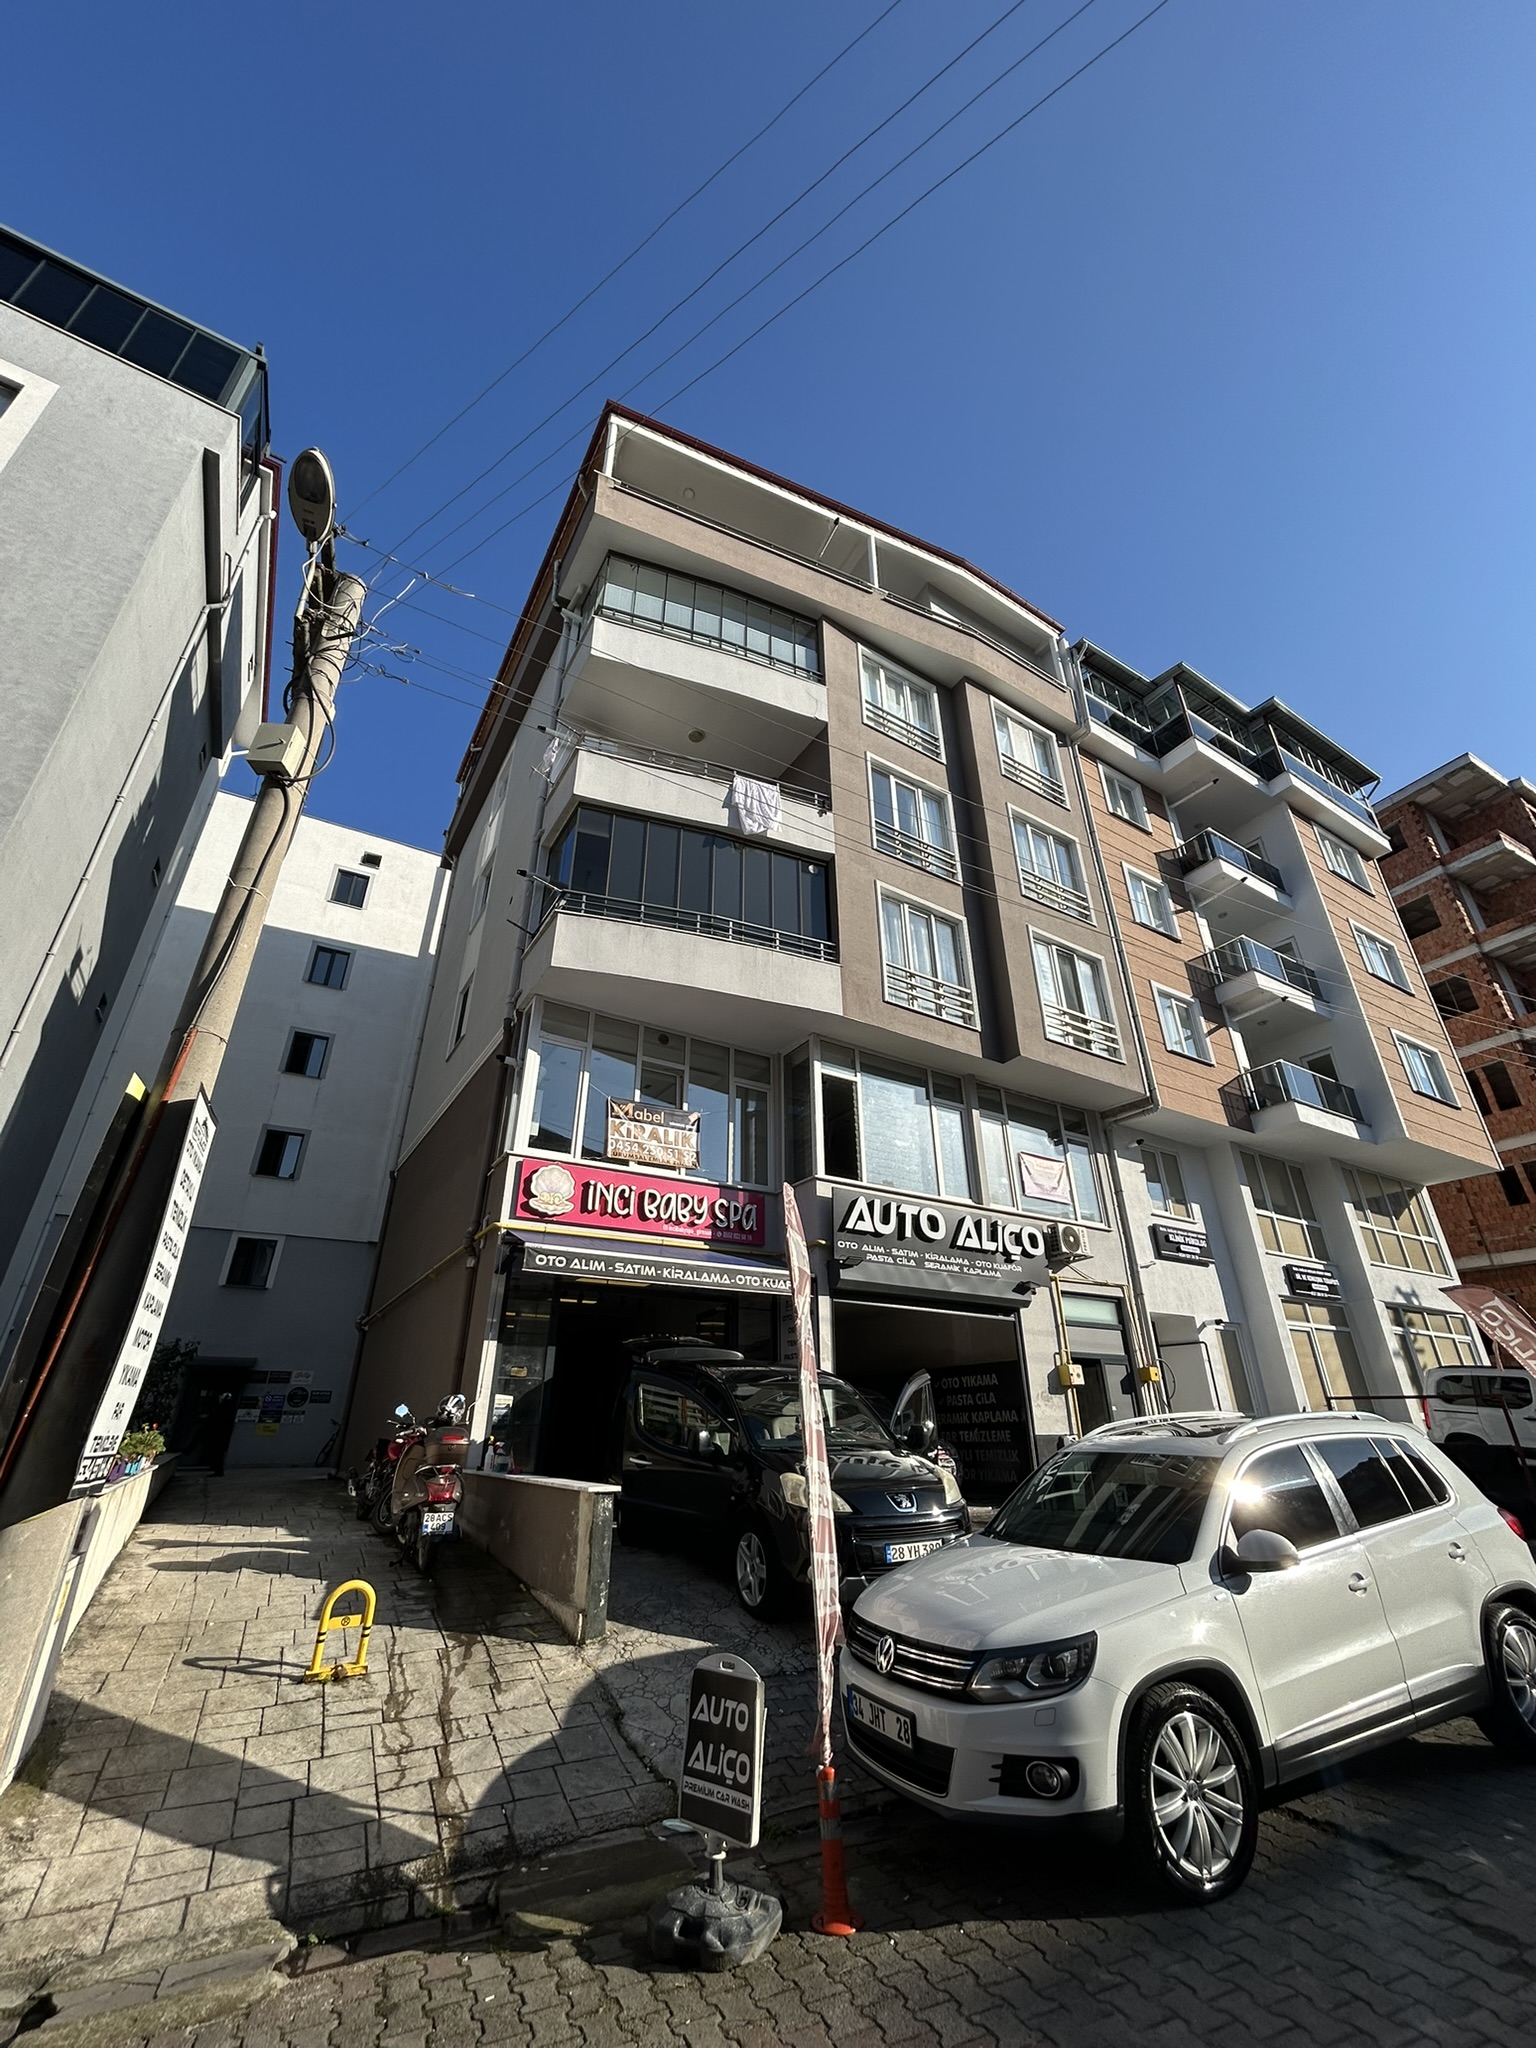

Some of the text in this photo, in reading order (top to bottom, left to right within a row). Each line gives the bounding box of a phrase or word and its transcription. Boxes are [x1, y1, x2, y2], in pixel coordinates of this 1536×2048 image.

[610, 1139, 639, 1152] 0454
[642, 1144, 664, 1156] 250
[845, 1195, 946, 1240] AUTO
[956, 1214, 1044, 1261] ALİÇO
[837, 1240, 858, 1249] OTO
[861, 1244, 885, 1253] ALIM
[891, 1248, 919, 1258] SATIM
[925, 1252, 970, 1265] KİRALAMA
[975, 1260, 992, 1268] OTO
[535, 1254, 566, 1267] OTO
[569, 1258, 605, 1271] ALIM
[614, 1262, 656, 1276] SATIM
[663, 1266, 731, 1284] KİRALAMA
[736, 1275, 760, 1286] OTO
[866, 1253, 894, 1263] PASTA
[963, 1266, 1001, 1277] KAPLAMA
[941, 1374, 998, 1389] OTO YIKAMA
[947, 1393, 974, 1406] PASTA
[971, 1410, 1018, 1423] KAPLAMA
[425, 1514, 436, 1522] 28
[431, 1523, 446, 1531] 409
[891, 1546, 905, 1560] 28
[907, 1544, 920, 1558] YH
[692, 1693, 749, 1732] AUTO
[869, 1702, 886, 1732] JHT
[896, 1716, 910, 1745] 28
[687, 1740, 750, 1785] ALİÇO
[716, 1790, 730, 1803] CAR
[730, 1795, 750, 1810] WASH
